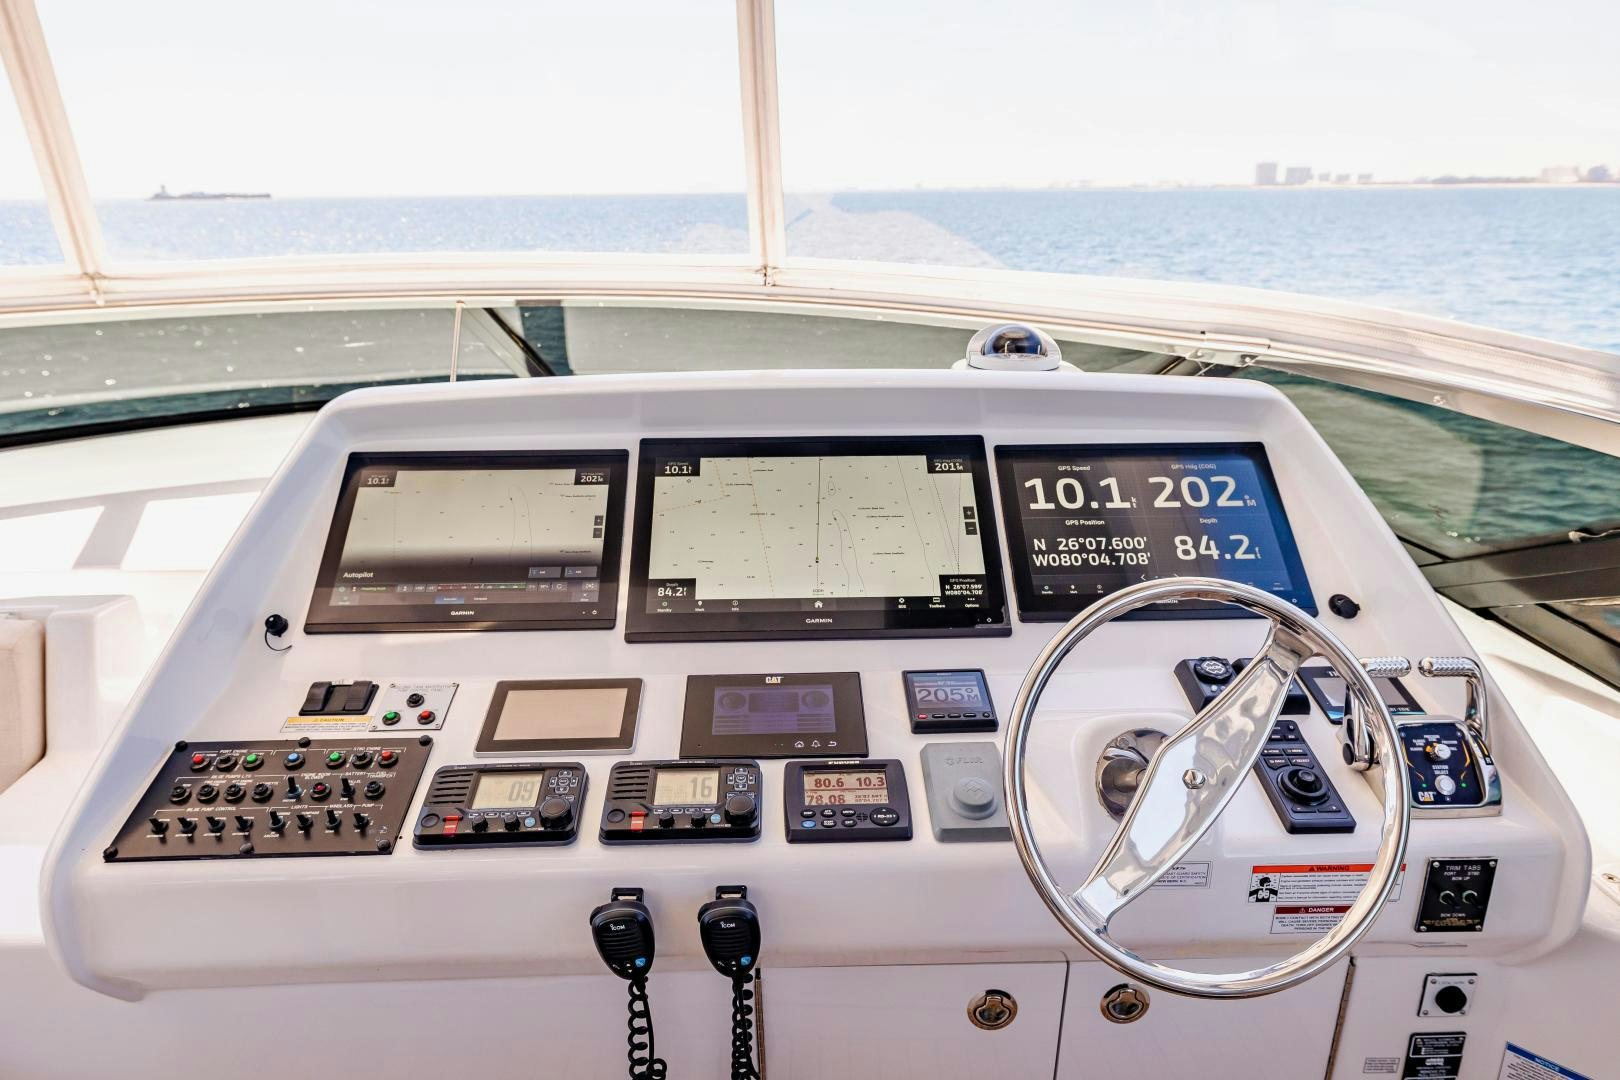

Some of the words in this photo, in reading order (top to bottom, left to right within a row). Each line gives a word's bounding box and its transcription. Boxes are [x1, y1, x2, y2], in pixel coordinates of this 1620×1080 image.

[1033, 538, 1047, 551] N
[343, 571, 374, 579] Autopilot
[765, 676, 782, 684] CAT
[814, 777, 845, 789] 80.6
[855, 776, 885, 788] 10.3
[508, 780, 535, 802] 09
[689, 777, 714, 800] 16
[1418, 791, 1436, 802] CAT
[1534, 1057, 1560, 1072] NOTICE
